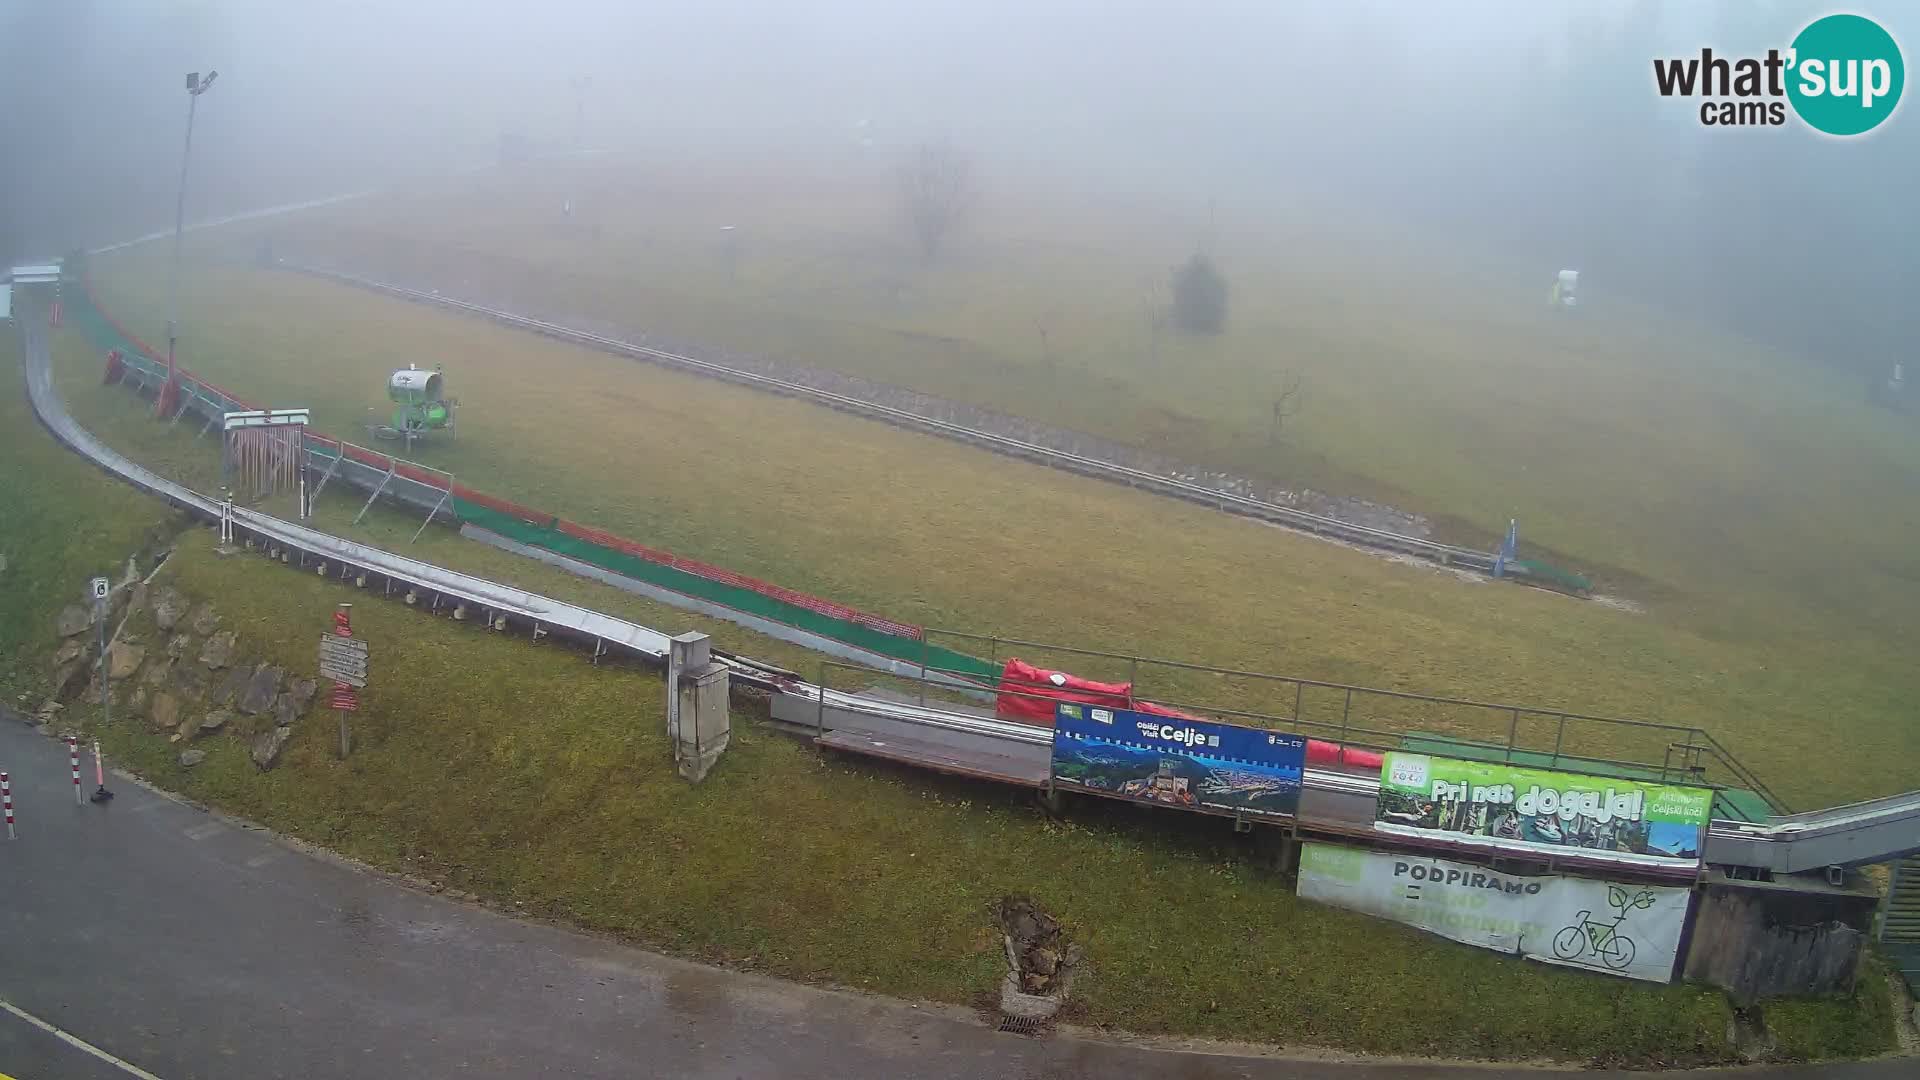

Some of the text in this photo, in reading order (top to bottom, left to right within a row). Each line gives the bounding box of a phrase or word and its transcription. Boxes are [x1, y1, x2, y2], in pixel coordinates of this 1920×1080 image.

[1160, 725, 1206, 747] Celje
[1431, 779, 1468, 802] Pri
[1472, 783, 1514, 804] nas
[1652, 802, 1682, 816] Celjski
[1393, 861, 1542, 895] PODPIRAMO
